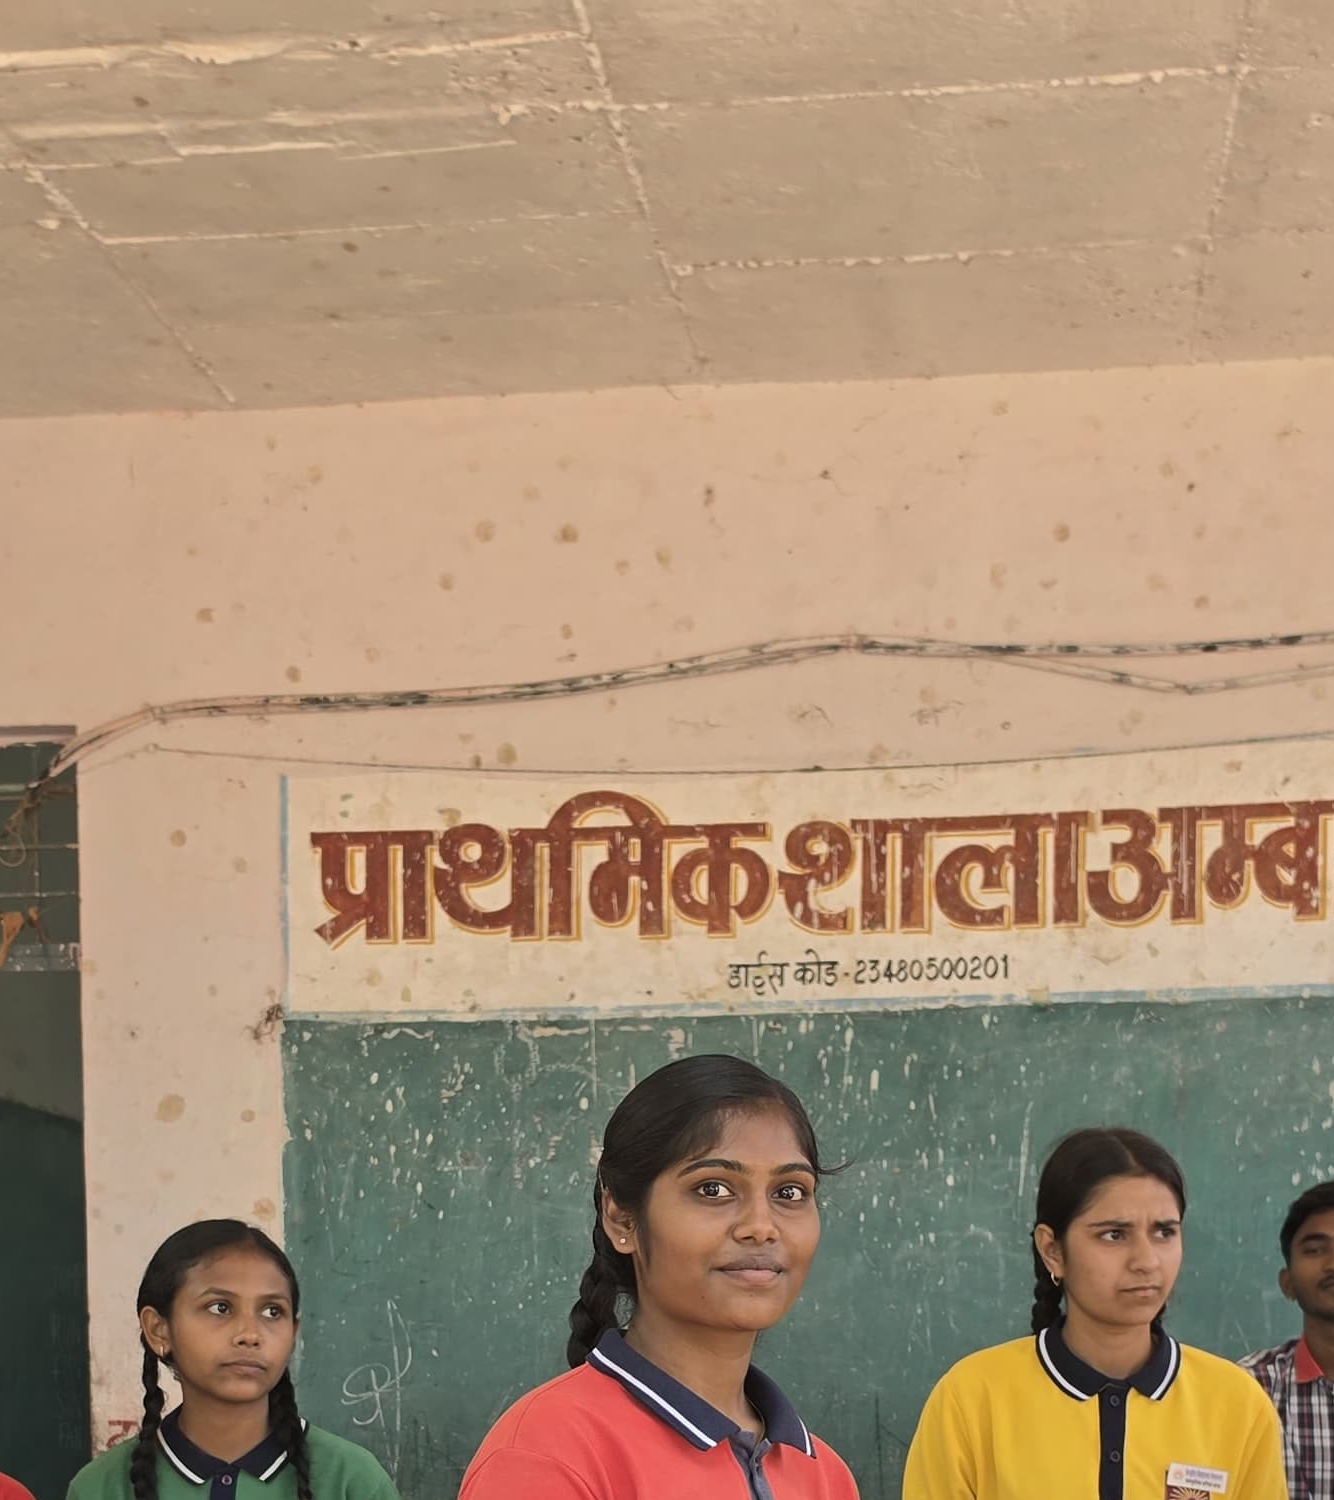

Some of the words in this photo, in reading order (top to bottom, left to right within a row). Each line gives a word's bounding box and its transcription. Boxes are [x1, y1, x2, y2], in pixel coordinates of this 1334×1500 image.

[309, 789, 779, 949] प्राथमिक
[776, 808, 1091, 936] शाला
[793, 948, 839, 987] कोड
[853, 953, 1010, 985] 23480500201
